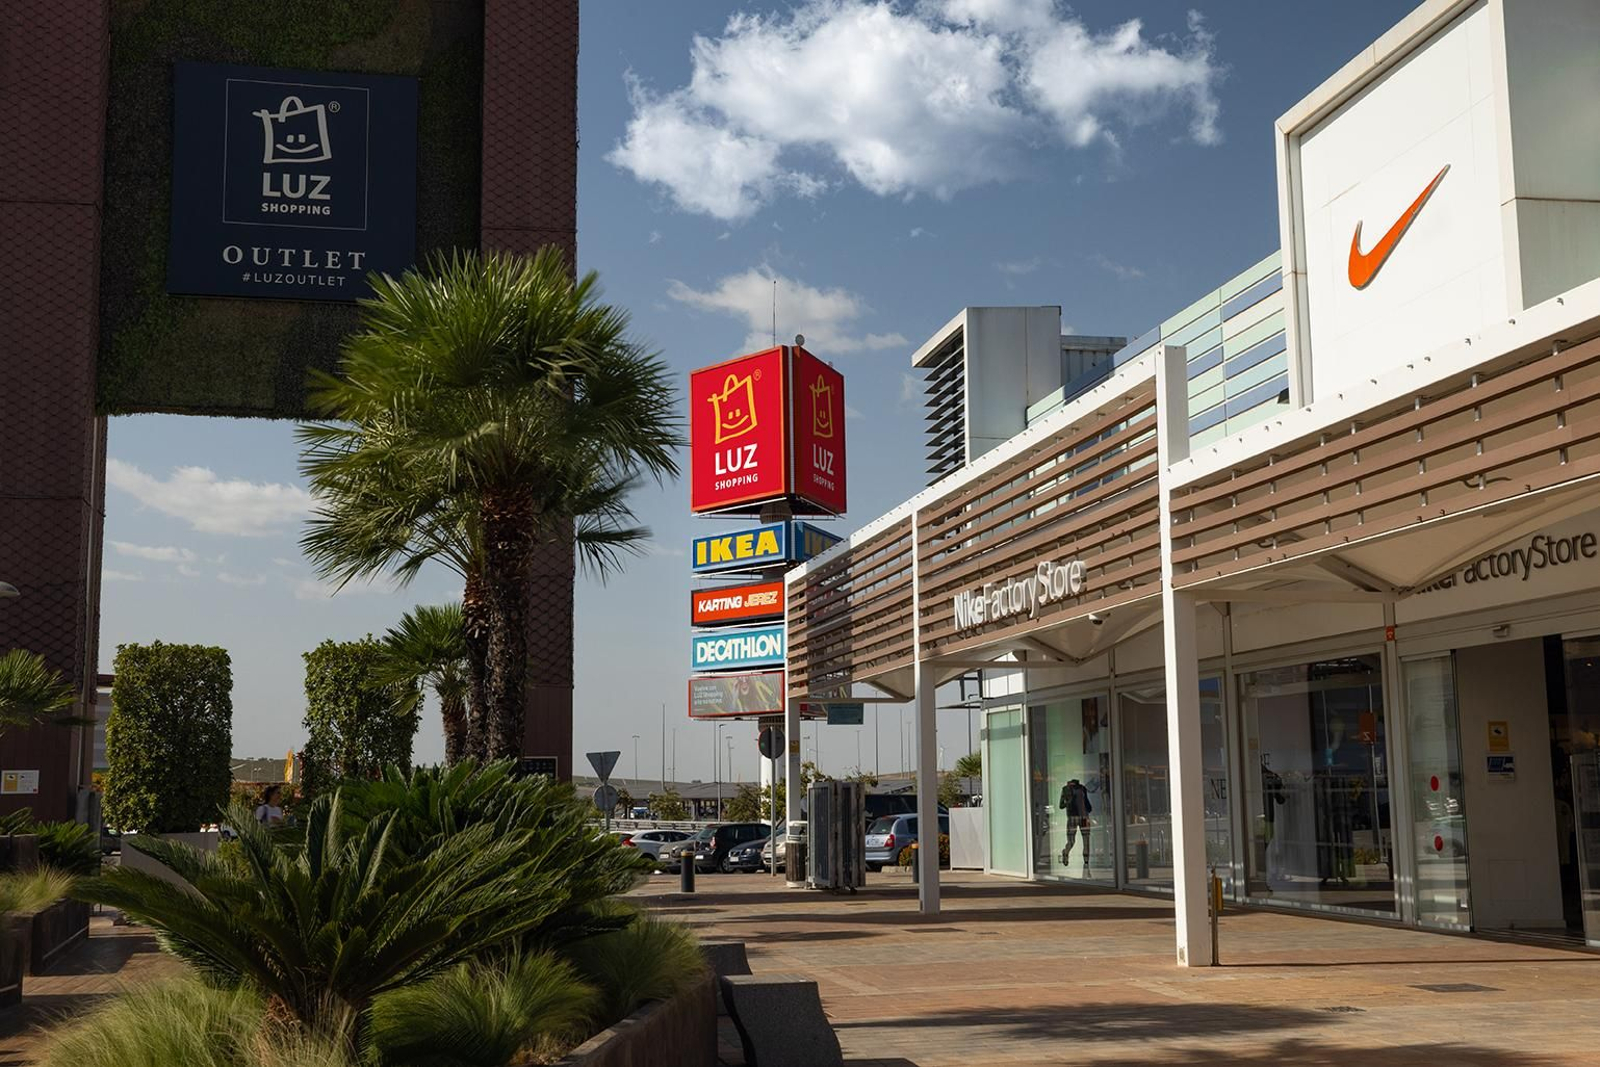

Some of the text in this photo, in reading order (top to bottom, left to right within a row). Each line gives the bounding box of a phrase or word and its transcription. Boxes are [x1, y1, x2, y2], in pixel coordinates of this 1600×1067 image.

[262, 172, 331, 200] LUZ
[261, 202, 331, 216] SHOPPING
[222, 245, 366, 270] OUTLET
[242, 273, 346, 287] #LUZOUTLET
[715, 443, 758, 475] LUZ
[813, 443, 834, 476] LUZ
[715, 473, 758, 491] SHOPPING
[813, 473, 835, 491] SHOPPING
[696, 530, 779, 565] IKEA
[698, 591, 779, 614] KARTING JEREZ
[696, 633, 781, 663] DECATHLON
